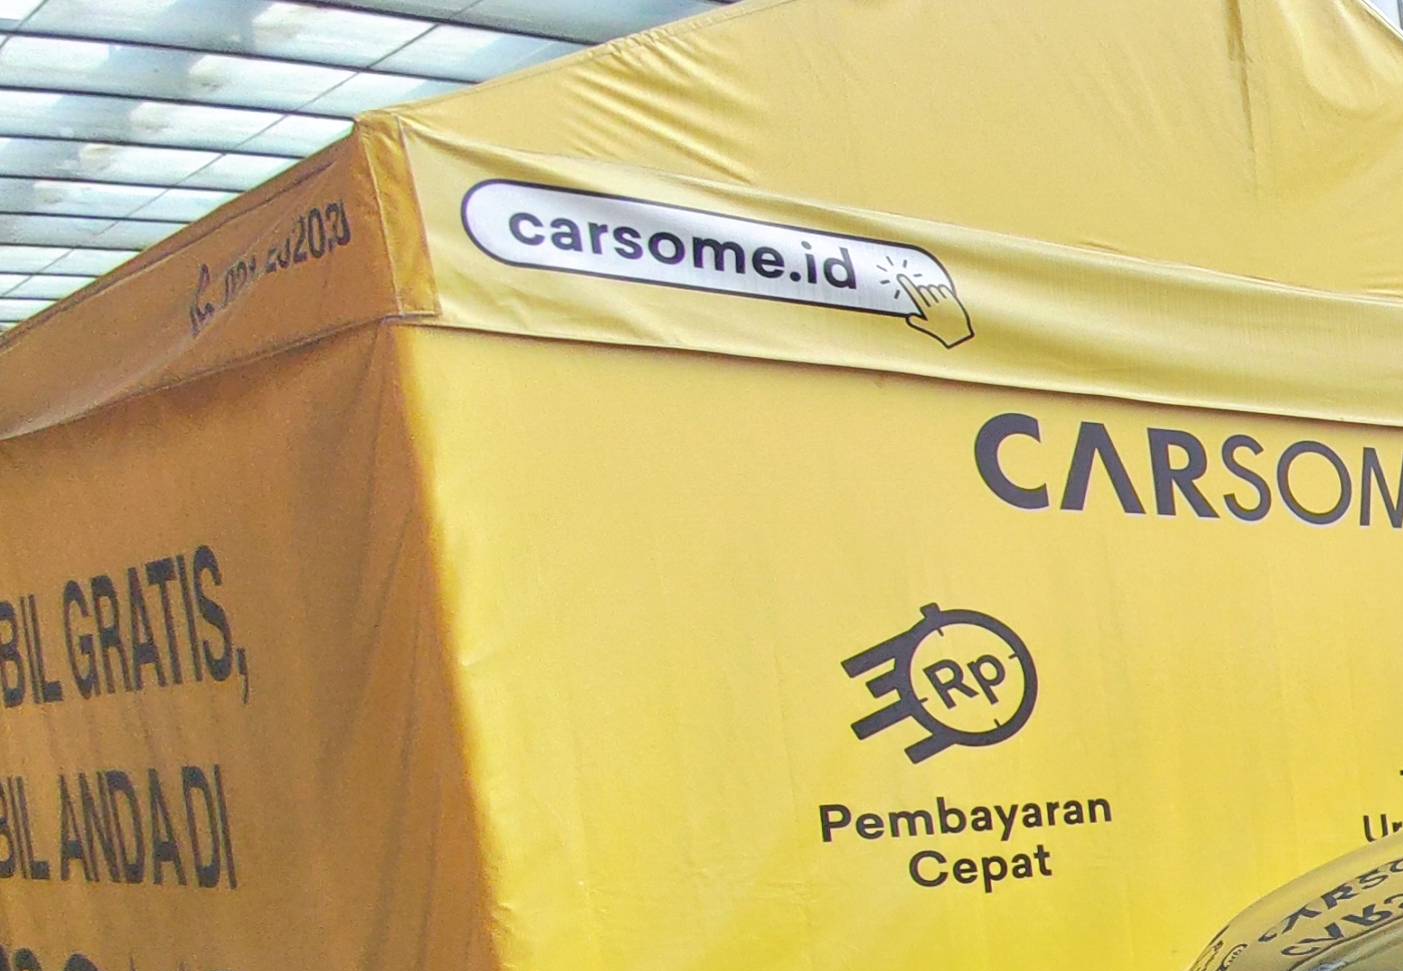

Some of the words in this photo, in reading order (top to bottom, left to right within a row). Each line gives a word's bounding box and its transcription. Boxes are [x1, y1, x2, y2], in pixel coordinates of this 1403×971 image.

[508, 211, 858, 290] carsome.id
[62, 545, 249, 704] GRATIS,
[818, 796, 1113, 843] Pembayaran
[908, 844, 1053, 894] Cepat
